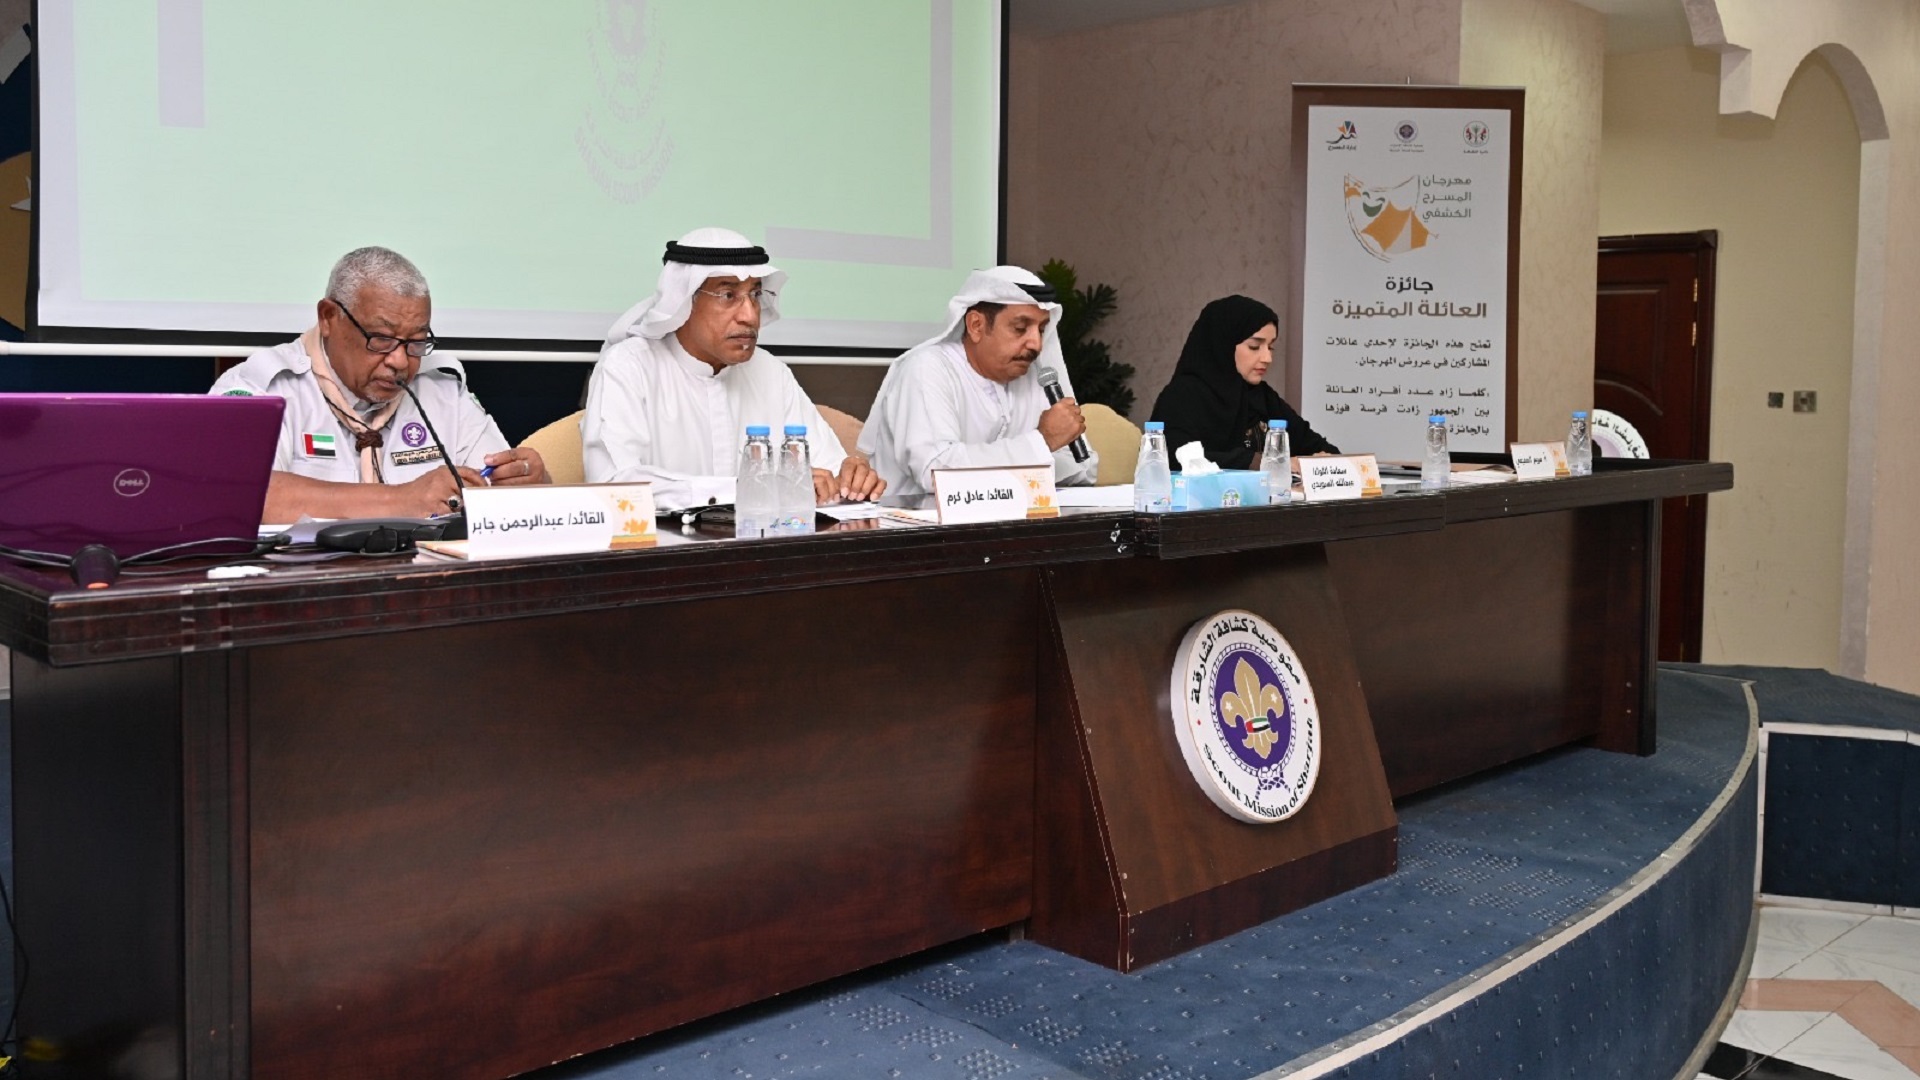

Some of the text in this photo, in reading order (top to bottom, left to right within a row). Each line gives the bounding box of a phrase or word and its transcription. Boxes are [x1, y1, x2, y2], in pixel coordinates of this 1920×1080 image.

[1422, 174, 1472, 186] مهرجان
[1422, 192, 1472, 204] المسرح
[1422, 208, 1472, 223] الكشفي
[1385, 276, 1434, 295] جائزة
[1332, 300, 1487, 319] العائلة المتميزة
[1326, 336, 1358, 346] عائلات
[1403, 338, 1439, 350] الجائزة
[1445, 338, 1464, 348] هذه
[1470, 339, 1491, 351] تمنح
[1399, 358, 1431, 369] عروض
[1433, 357, 1448, 370] في
[1450, 358, 1490, 369] المشاركين
[1326, 385, 1363, 394] العائلة
[1368, 384, 1401, 397] أفراد
[1408, 388, 1434, 396] عدد
[1439, 388, 1453, 398] زاد
[1326, 404, 1350, 415] فوزها
[1397, 404, 1421, 415] زادت
[1429, 405, 1465, 416] الجمهور
[1475, 407, 1490, 417] بين
[1449, 425, 1489, 437] بالجائزة
[119, 478, 145, 487] DELL
[947, 491, 961, 506] كرم
[964, 490, 985, 504] عادل
[471, 511, 605, 535] القائد/ عبدالرحمن جابر
[1213, 616, 1250, 638] كشافة
[1191, 632, 1217, 705] الشارقة
[1203, 717, 1314, 818] Scout Mission of Sharjah
